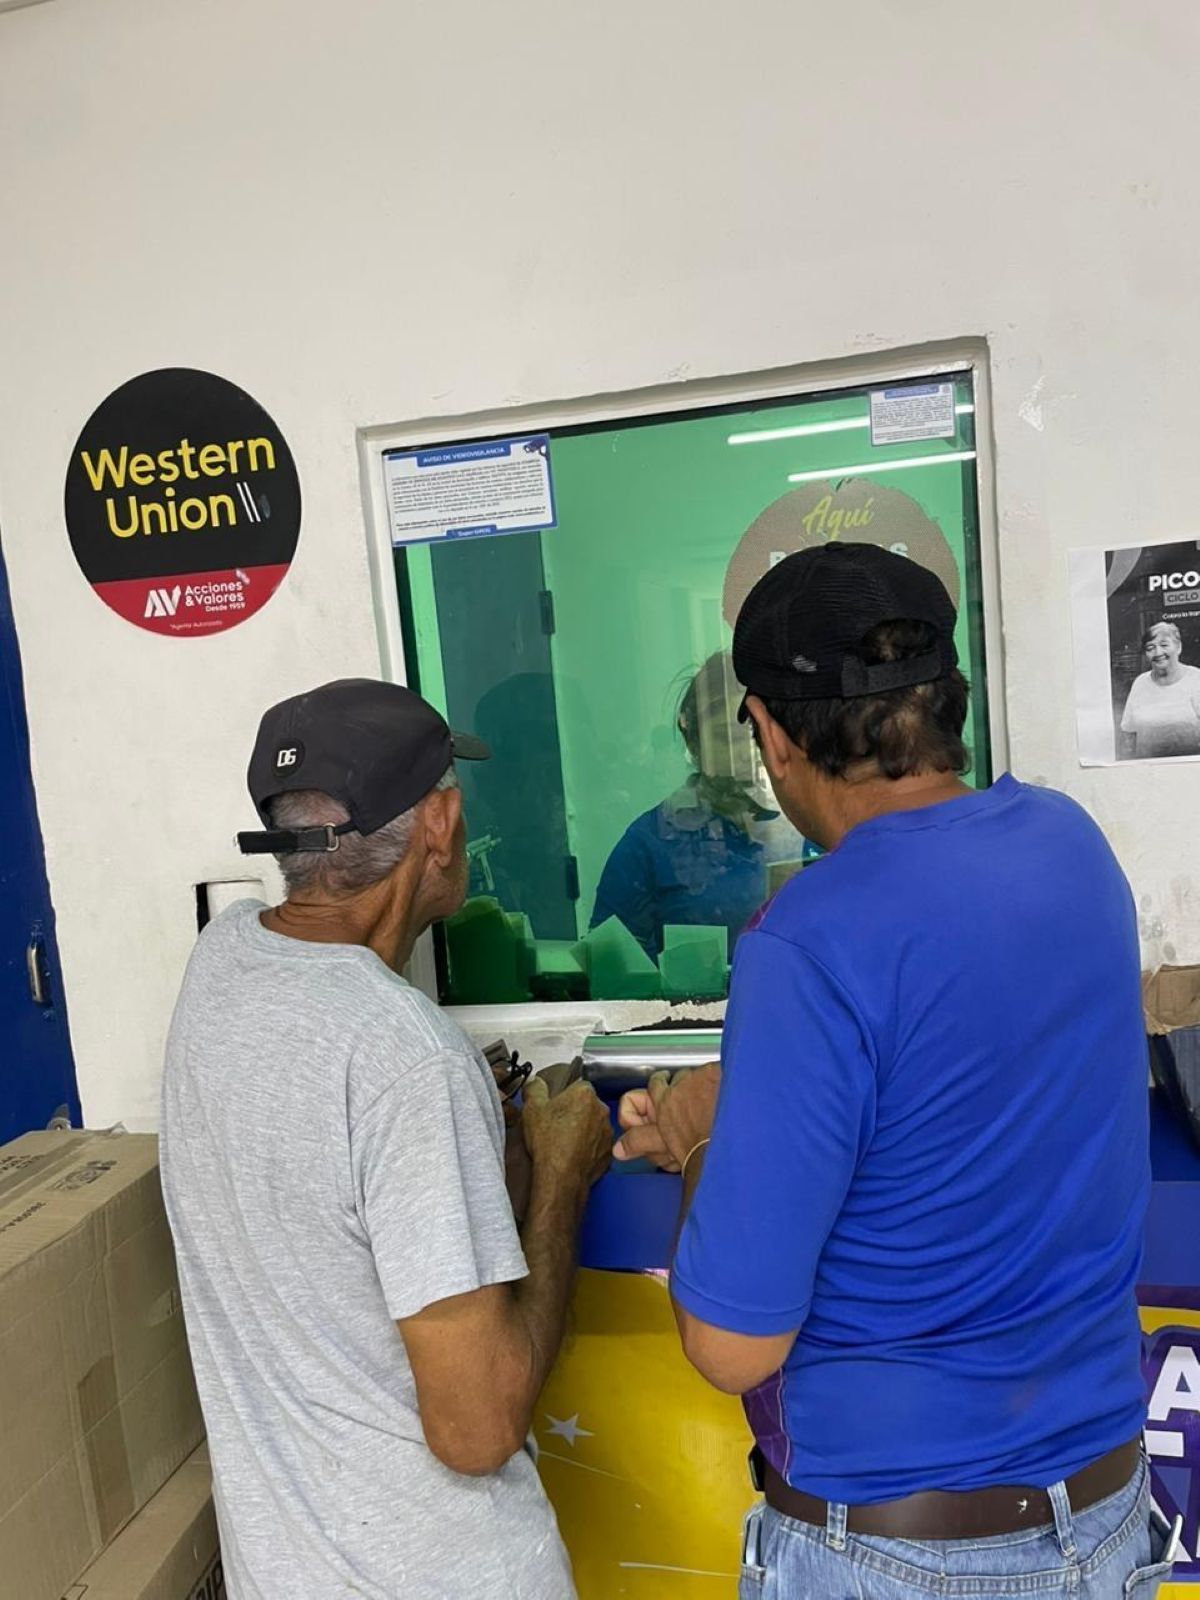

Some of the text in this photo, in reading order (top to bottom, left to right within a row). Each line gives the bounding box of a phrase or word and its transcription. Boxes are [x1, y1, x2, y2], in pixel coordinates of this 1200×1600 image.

[81, 437, 276, 492] Western
[106, 486, 236, 538] Union
[802, 495, 874, 541] Aquí
[185, 582, 243, 596] Acciones
[1149, 571, 1200, 591] PICO
[1167, 592, 1199, 602] CICLO
[205, 604, 228, 612] Desde
[277, 747, 297, 767] DG
